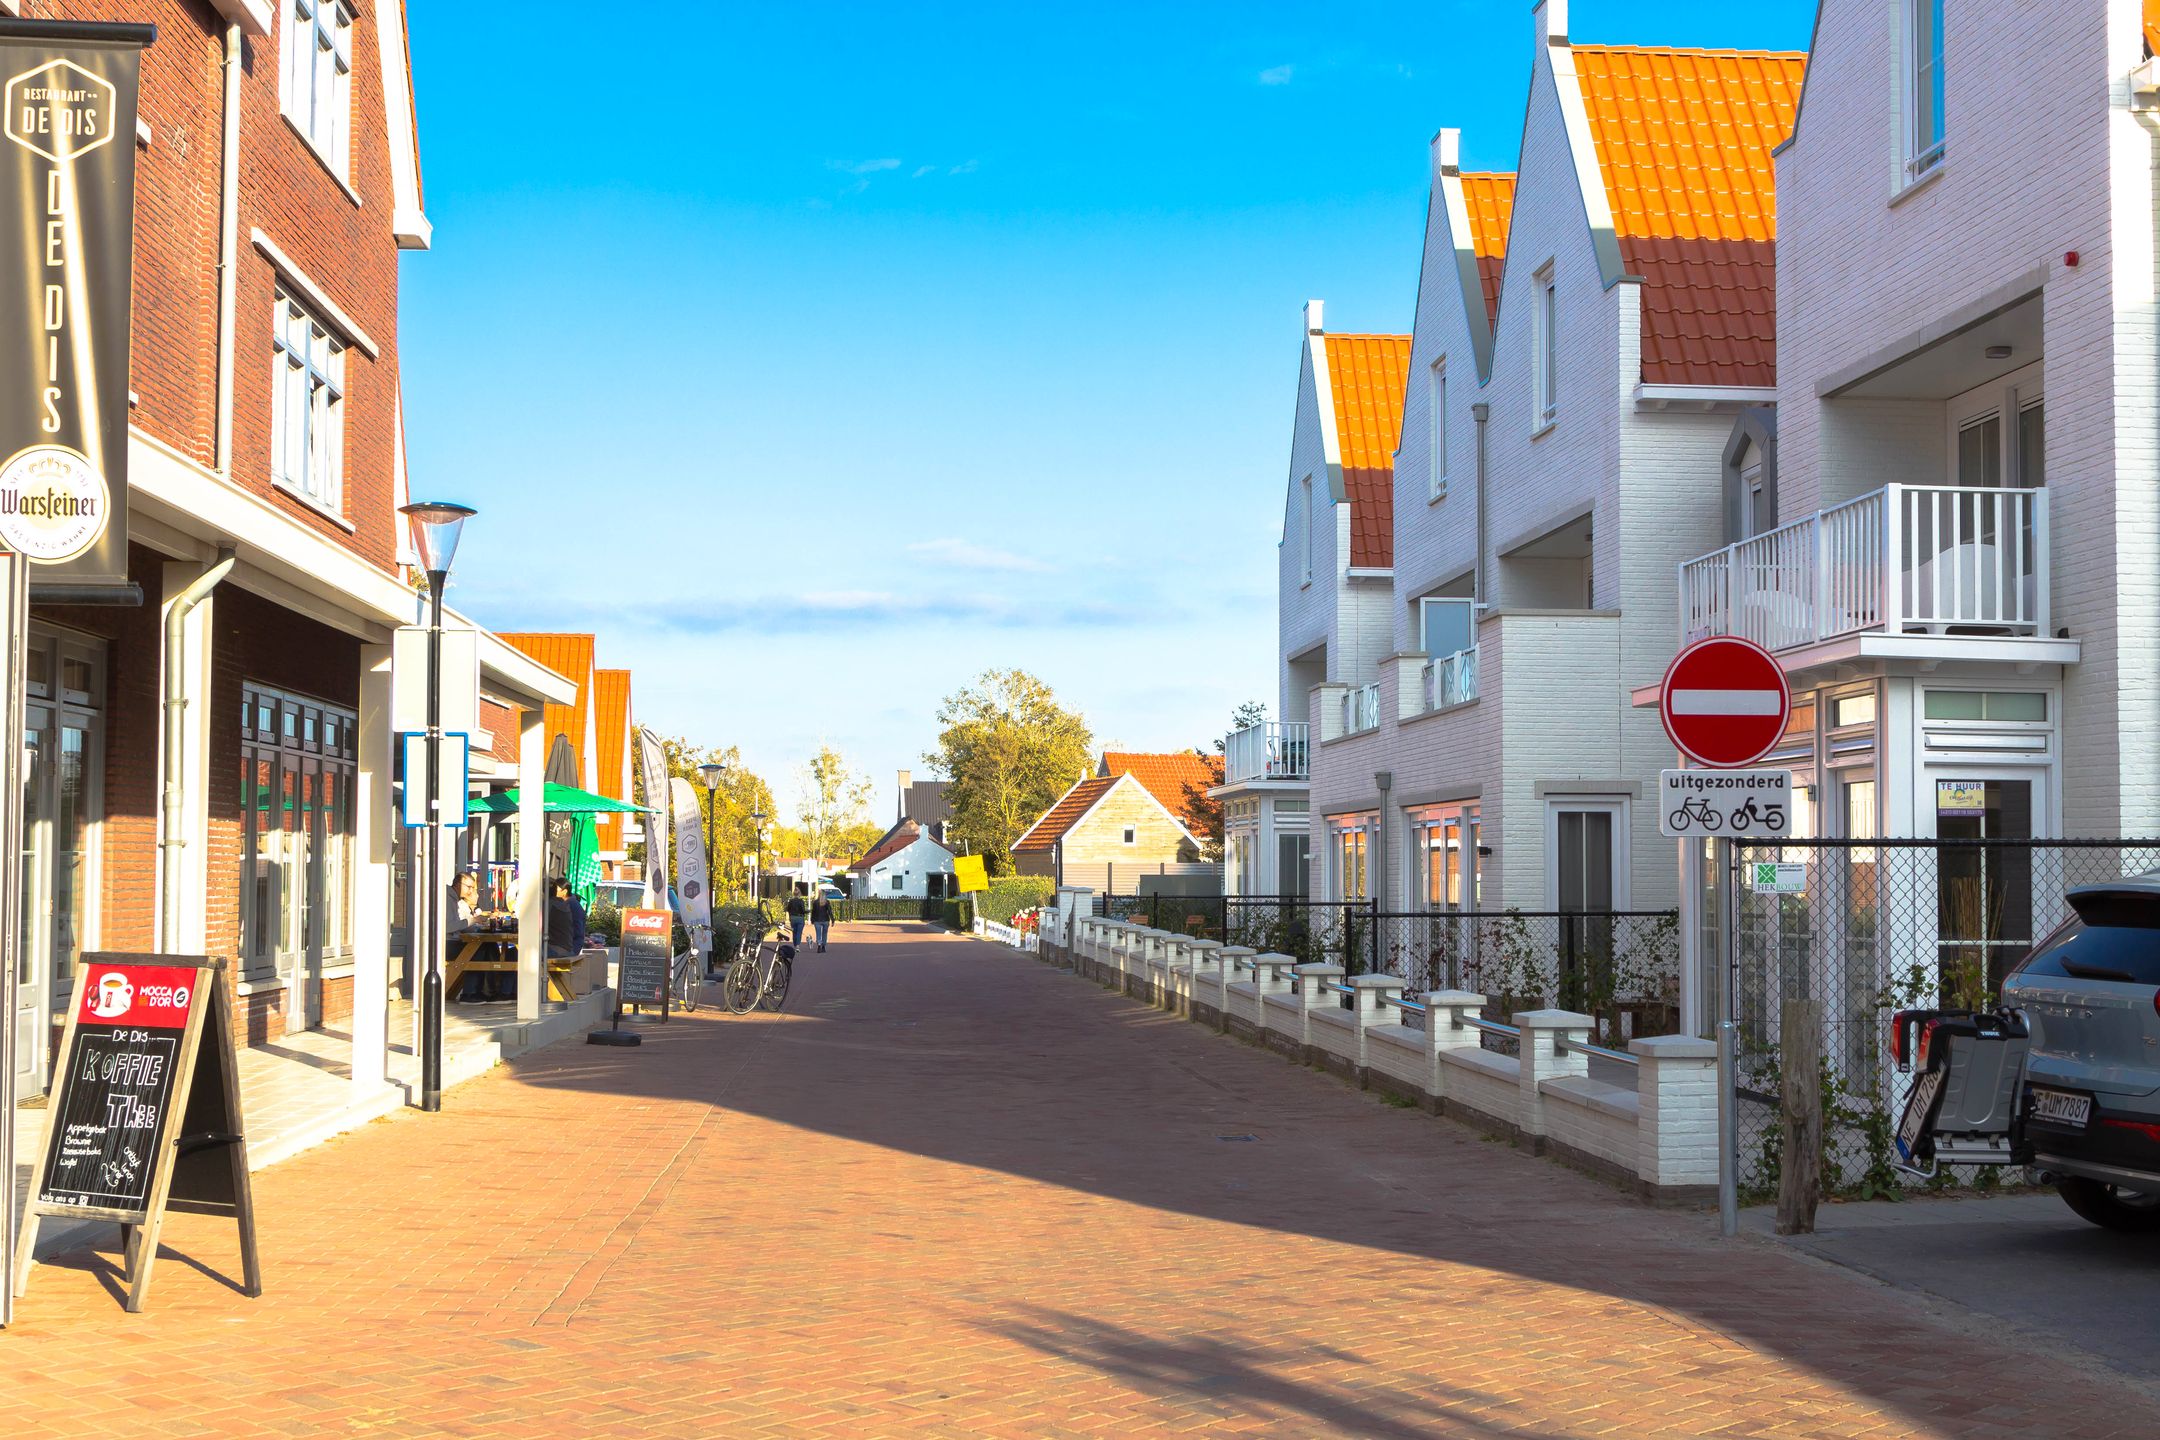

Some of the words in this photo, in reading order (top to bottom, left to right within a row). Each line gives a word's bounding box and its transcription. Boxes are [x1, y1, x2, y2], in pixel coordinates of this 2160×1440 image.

[23, 88, 86, 102] RESTAURANT
[23, 106, 50, 134] DE
[60, 108, 97, 136] DIS
[47, 169, 65, 267] DE
[42, 284, 64, 432] DIS
[1, 487, 97, 519] Warsteiner
[1669, 775, 1784, 792] uitgezonderd
[1941, 782, 1953, 791] TE
[1956, 782, 1982, 791] HUUR
[139, 985, 173, 996] MOCCA
[149, 996, 171, 1007] D'OR
[82, 1048, 164, 1086] KOFFIE
[1901, 1121, 1915, 1148] NE
[1913, 1092, 1930, 1120] UM
[2048, 1093, 2063, 1114] UM
[2063, 1097, 2088, 1119] 7887
